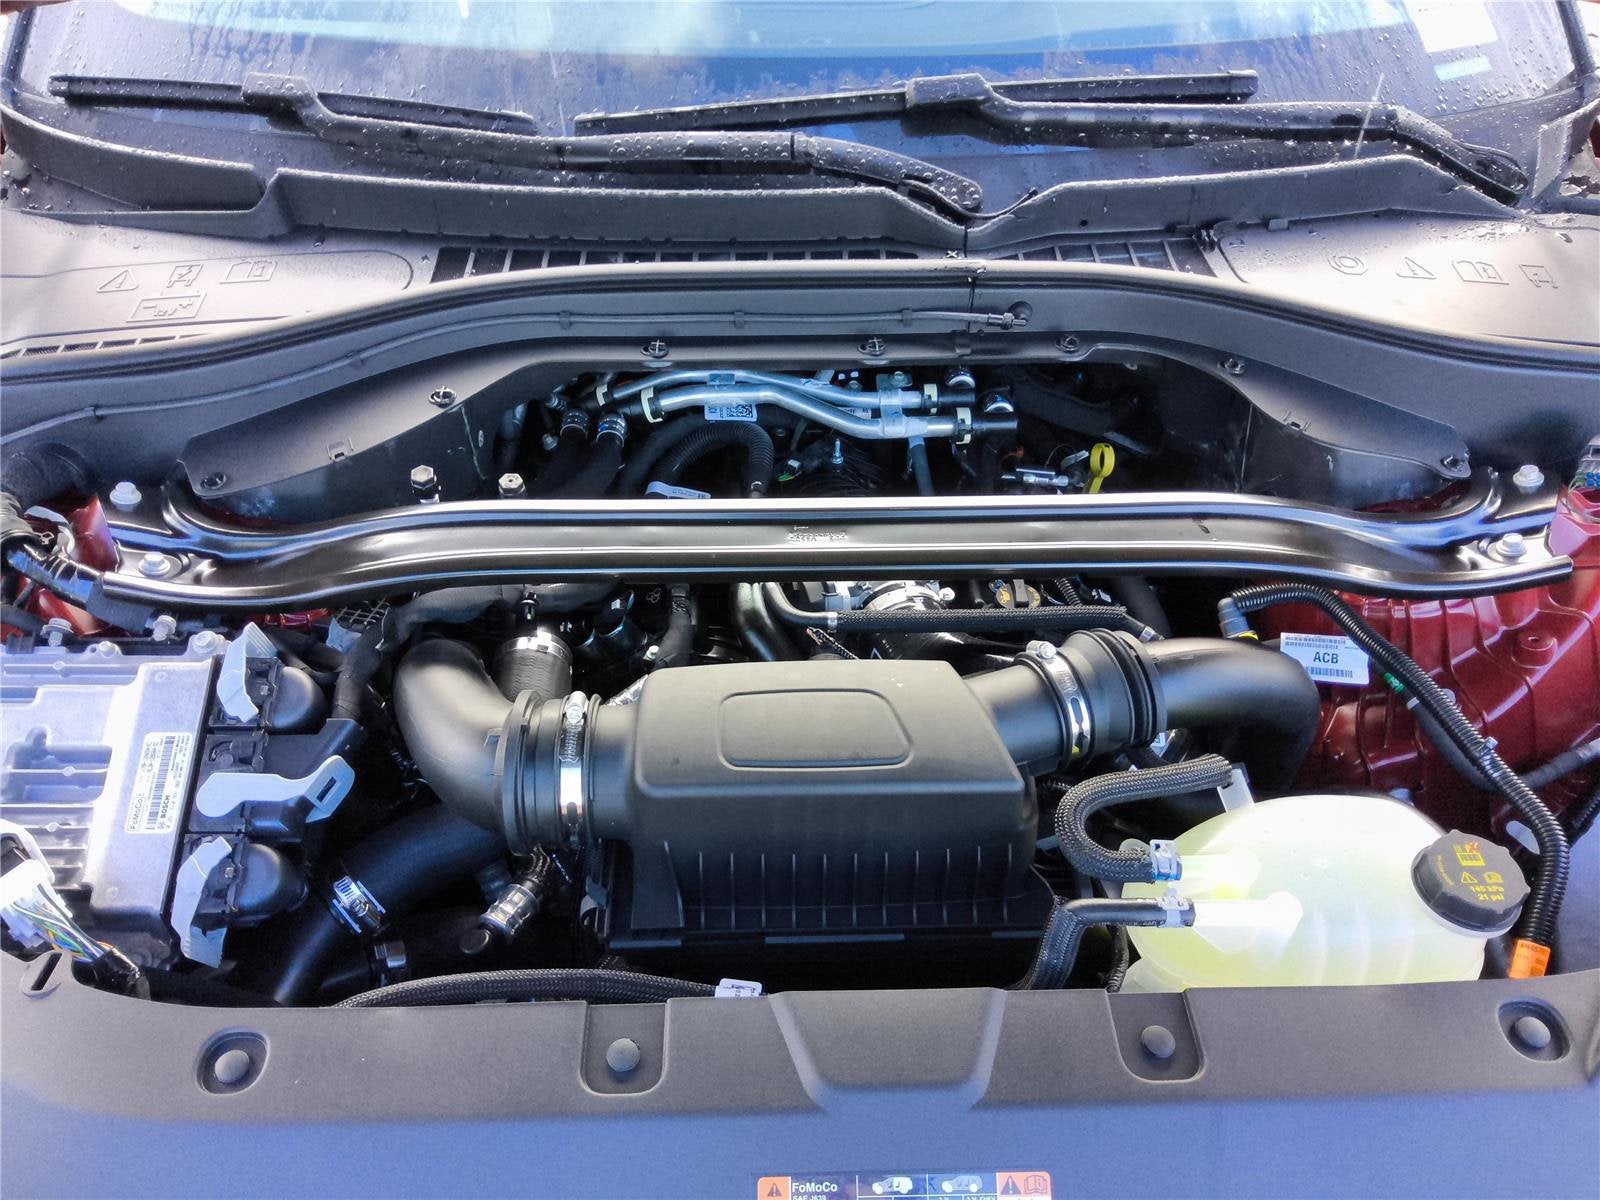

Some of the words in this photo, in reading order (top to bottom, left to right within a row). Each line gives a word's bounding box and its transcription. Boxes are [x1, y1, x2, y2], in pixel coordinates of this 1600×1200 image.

[1313, 651, 1339, 664] ACB
[129, 799, 143, 830] FoMoCo
[160, 795, 171, 819] BOSCH
[791, 1182, 838, 1193] FoMoCo
